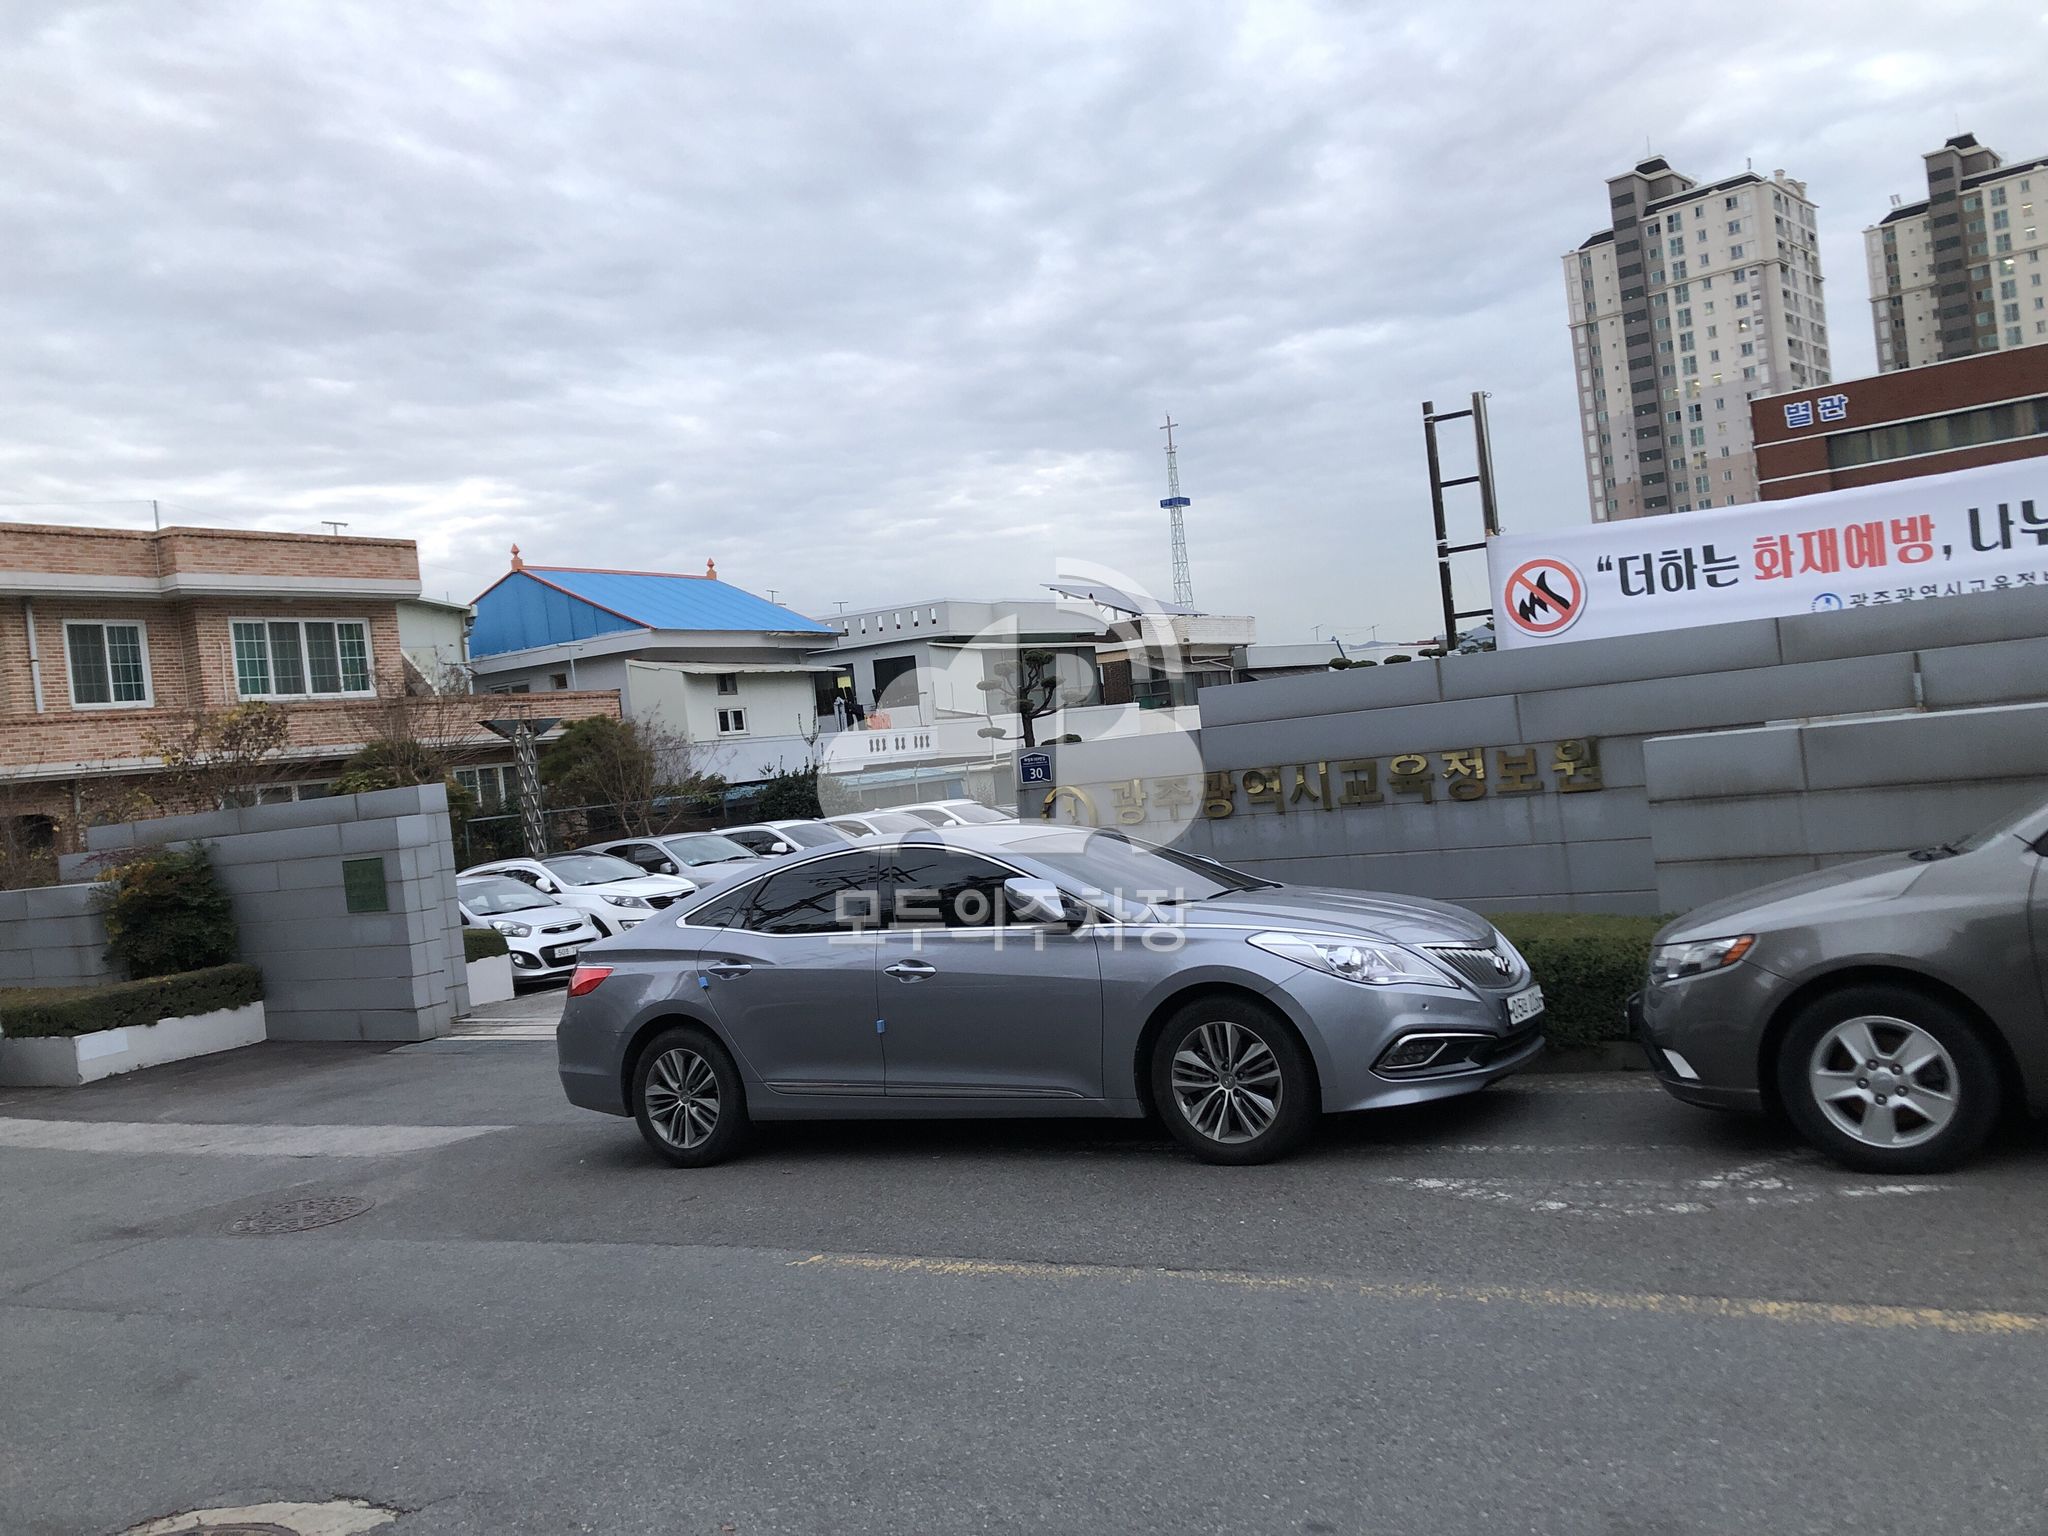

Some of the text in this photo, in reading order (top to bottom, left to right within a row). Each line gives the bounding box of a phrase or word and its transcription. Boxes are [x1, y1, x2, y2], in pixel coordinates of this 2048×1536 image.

[1784, 394, 1848, 428] 별관
[1753, 514, 1952, 580] 화재예방,
[1029, 767, 1043, 779] 30
[1112, 735, 1603, 825] 광주광역시교육정보원
